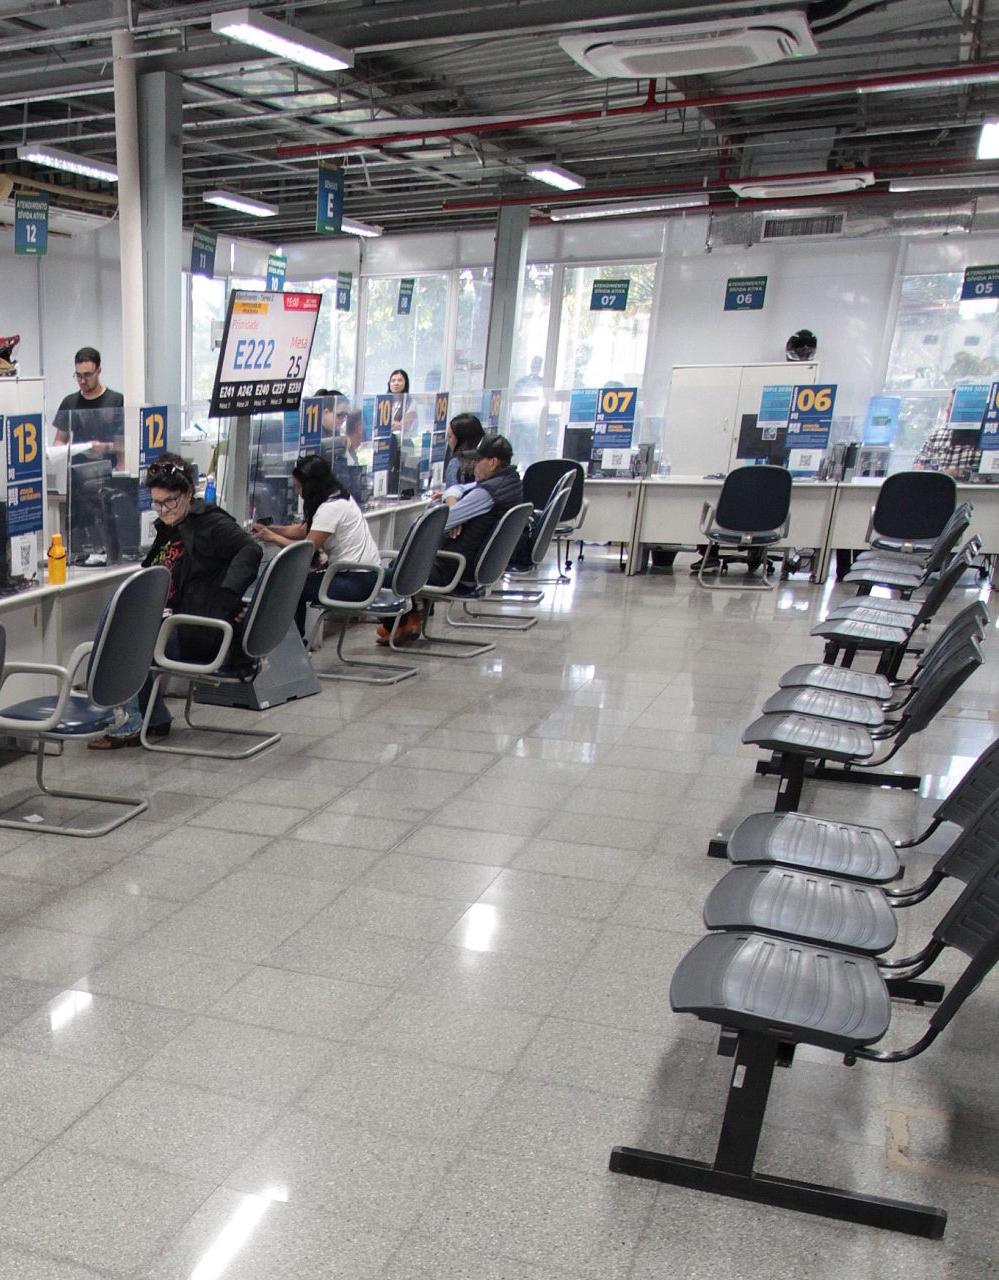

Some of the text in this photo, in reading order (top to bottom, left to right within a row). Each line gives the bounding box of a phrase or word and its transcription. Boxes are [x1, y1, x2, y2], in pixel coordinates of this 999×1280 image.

[327, 192, 334, 218] E
[26, 224, 37, 243] 12
[736, 294, 752, 305] 06
[975, 283, 994, 294] 05
[601, 295, 617, 306] 07
[290, 336, 309, 349] Mesa
[233, 339, 275, 370] E222
[286, 356, 303, 378] 25
[219, 386, 235, 398] E241
[237, 384, 253, 397] A242
[602, 391, 634, 414] 07
[797, 387, 832, 412] 06
[305, 404, 319, 433] 11
[378, 399, 391, 426] 10
[145, 413, 164, 449] 12
[13, 422, 38, 464] 13
